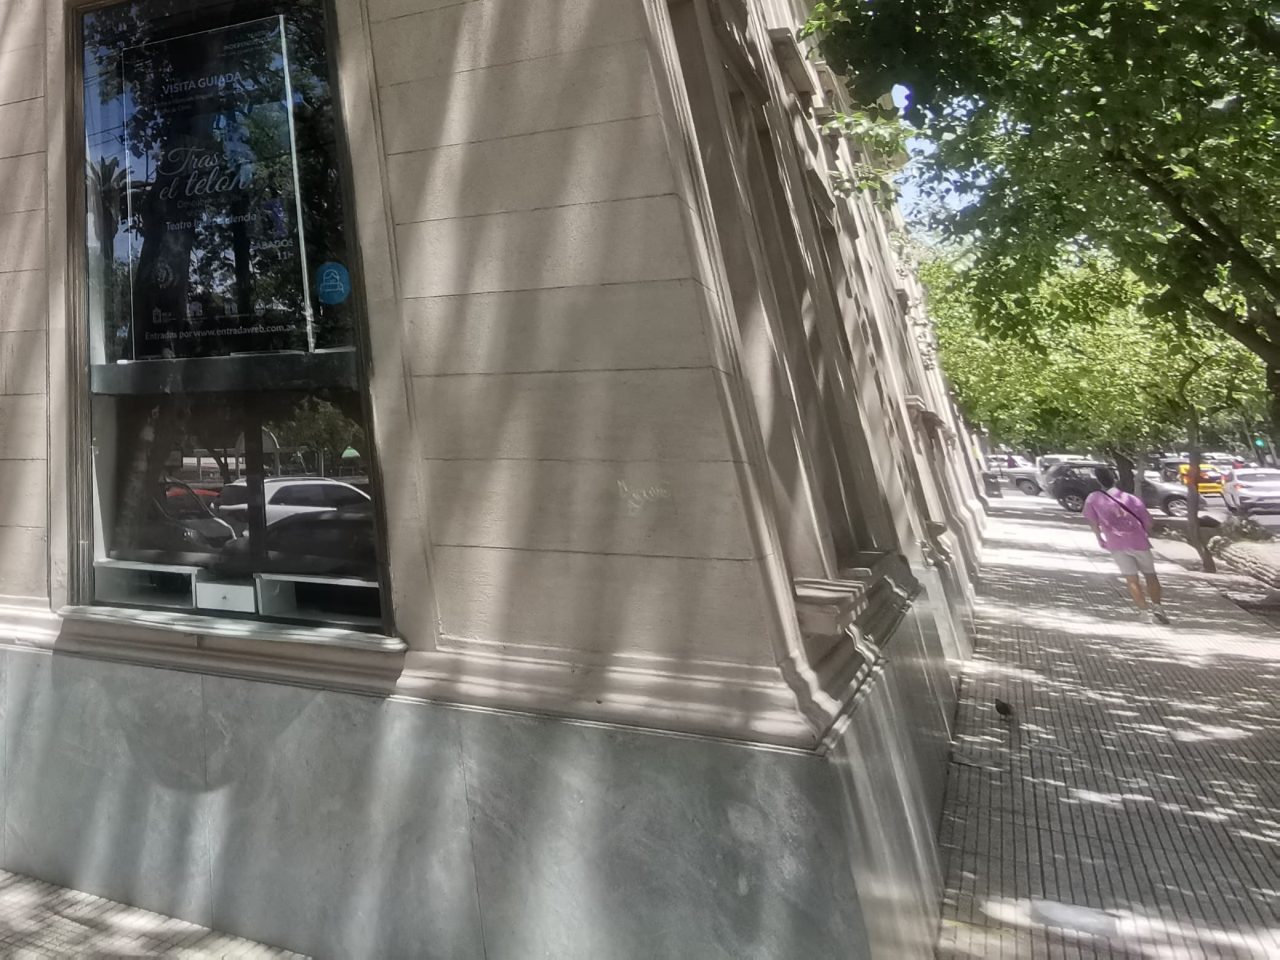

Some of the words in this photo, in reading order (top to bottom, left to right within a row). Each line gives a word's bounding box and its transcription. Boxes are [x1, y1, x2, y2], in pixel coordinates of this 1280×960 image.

[162, 80, 196, 95] VISITA
[197, 71, 243, 88] GUIADA
[159, 146, 219, 176] Tras
[160, 177, 179, 200] el
[165, 220, 192, 231] Teatro
[193, 212, 257, 227] Indencia
[145, 330, 177, 340] Entradas
[179, 330, 192, 339] por
